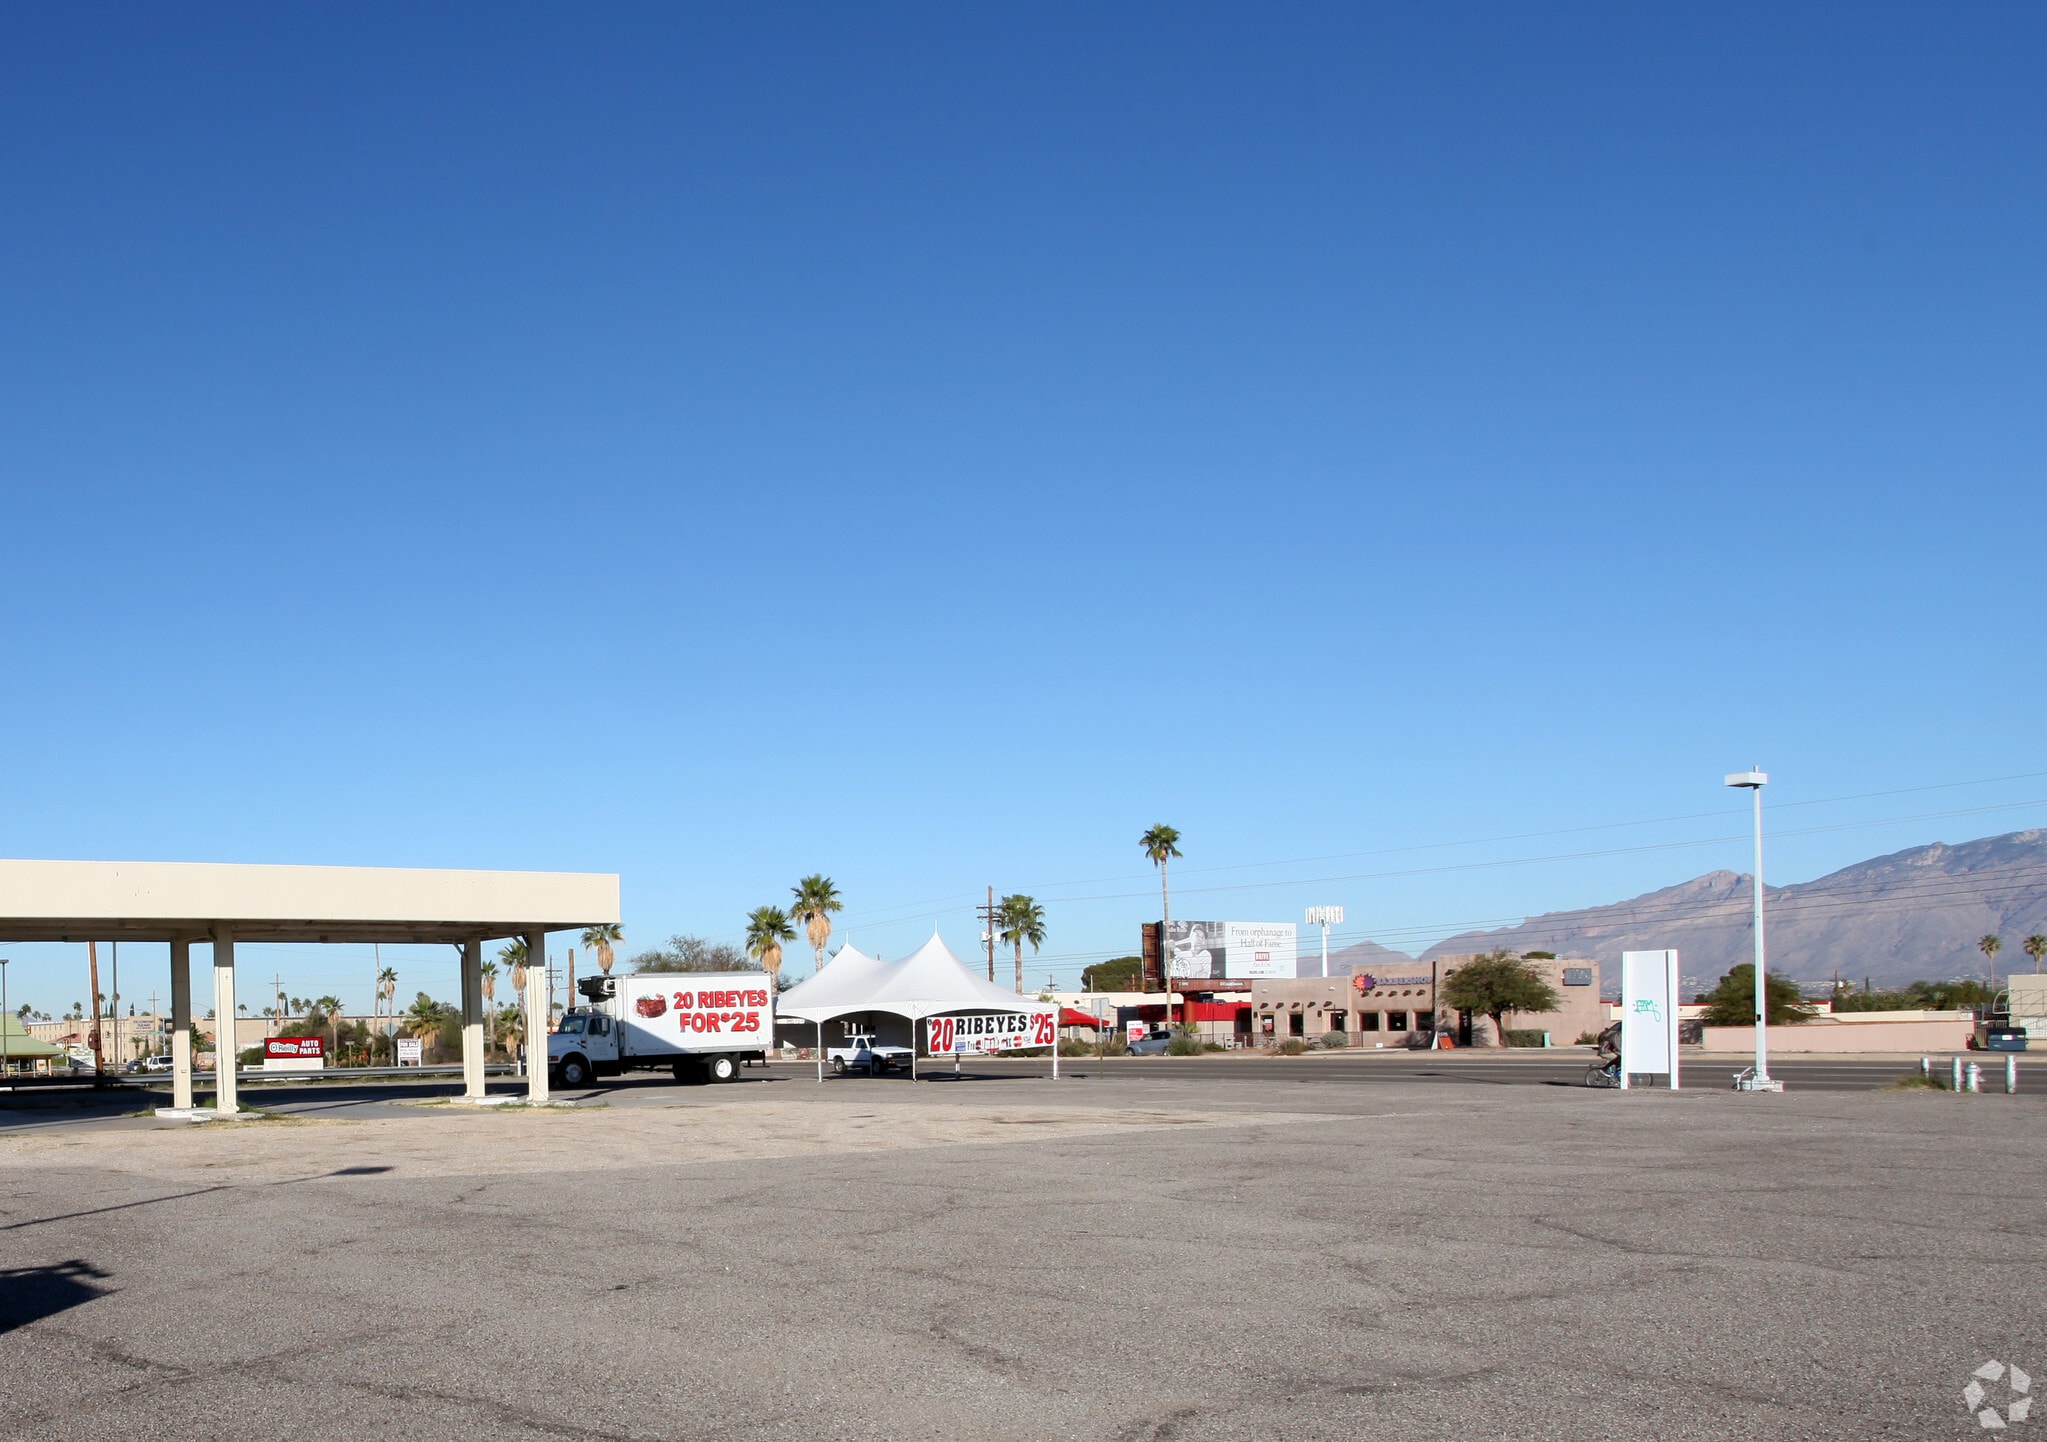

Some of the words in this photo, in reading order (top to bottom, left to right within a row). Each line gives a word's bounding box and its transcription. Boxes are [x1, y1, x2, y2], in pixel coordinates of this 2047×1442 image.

[1231, 926, 1249, 936] From
[1250, 926, 1283, 939] orphanage
[1284, 928, 1292, 936] to
[1240, 938, 1255, 948] Hall
[1255, 938, 1263, 948] of
[674, 991, 694, 1009] 20
[698, 989, 768, 1008] RIBEYES
[680, 1012, 721, 1033] FOR
[930, 1018, 954, 1052] 20
[955, 1014, 1027, 1035] RIBEYES
[1030, 1012, 1055, 1045] $25
[270, 1042, 298, 1054] O'Reilly
[301, 1039, 319, 1047] AUTO
[299, 1047, 320, 1055] PARTS
